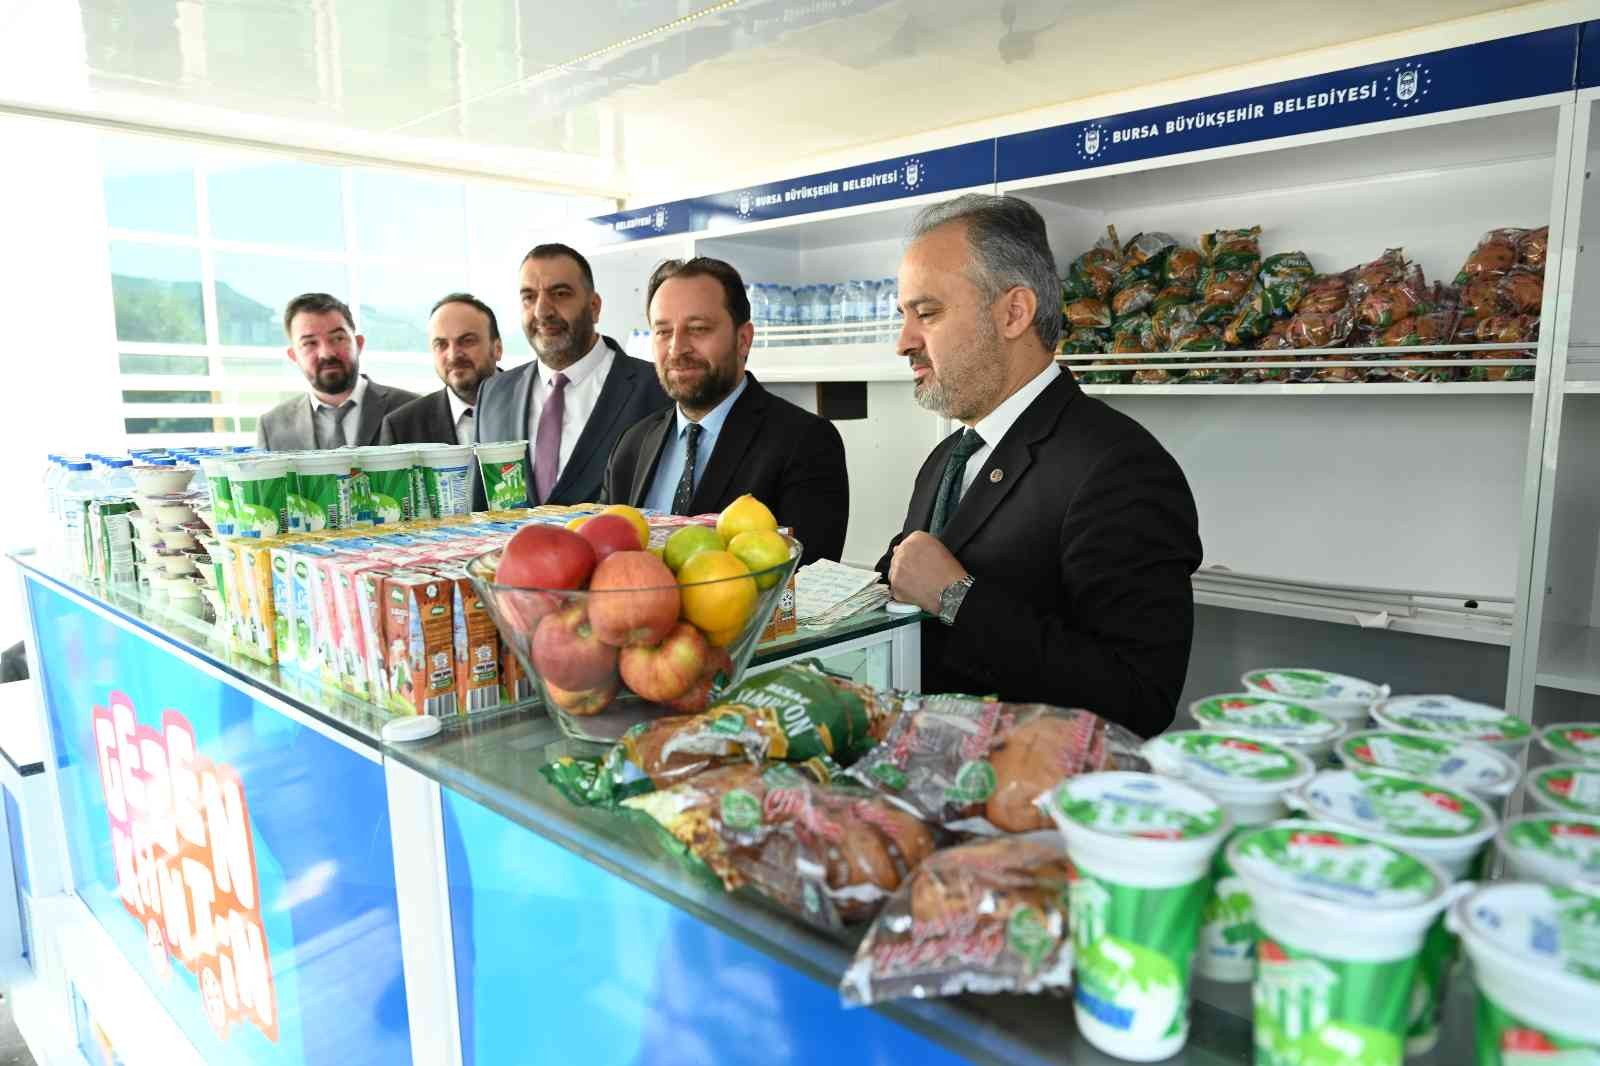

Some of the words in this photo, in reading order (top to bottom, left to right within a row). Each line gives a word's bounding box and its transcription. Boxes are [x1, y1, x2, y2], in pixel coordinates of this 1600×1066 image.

[1112, 125, 1159, 143] BURSA
[1165, 103, 1265, 135] BÜYÜKŞEHİR
[1273, 80, 1378, 115] BELEDİYESİ
[755, 194, 783, 208] BURSA
[785, 180, 839, 202] BÜYÜKŞEHİR
[842, 170, 899, 192] BELEDİYESİ
